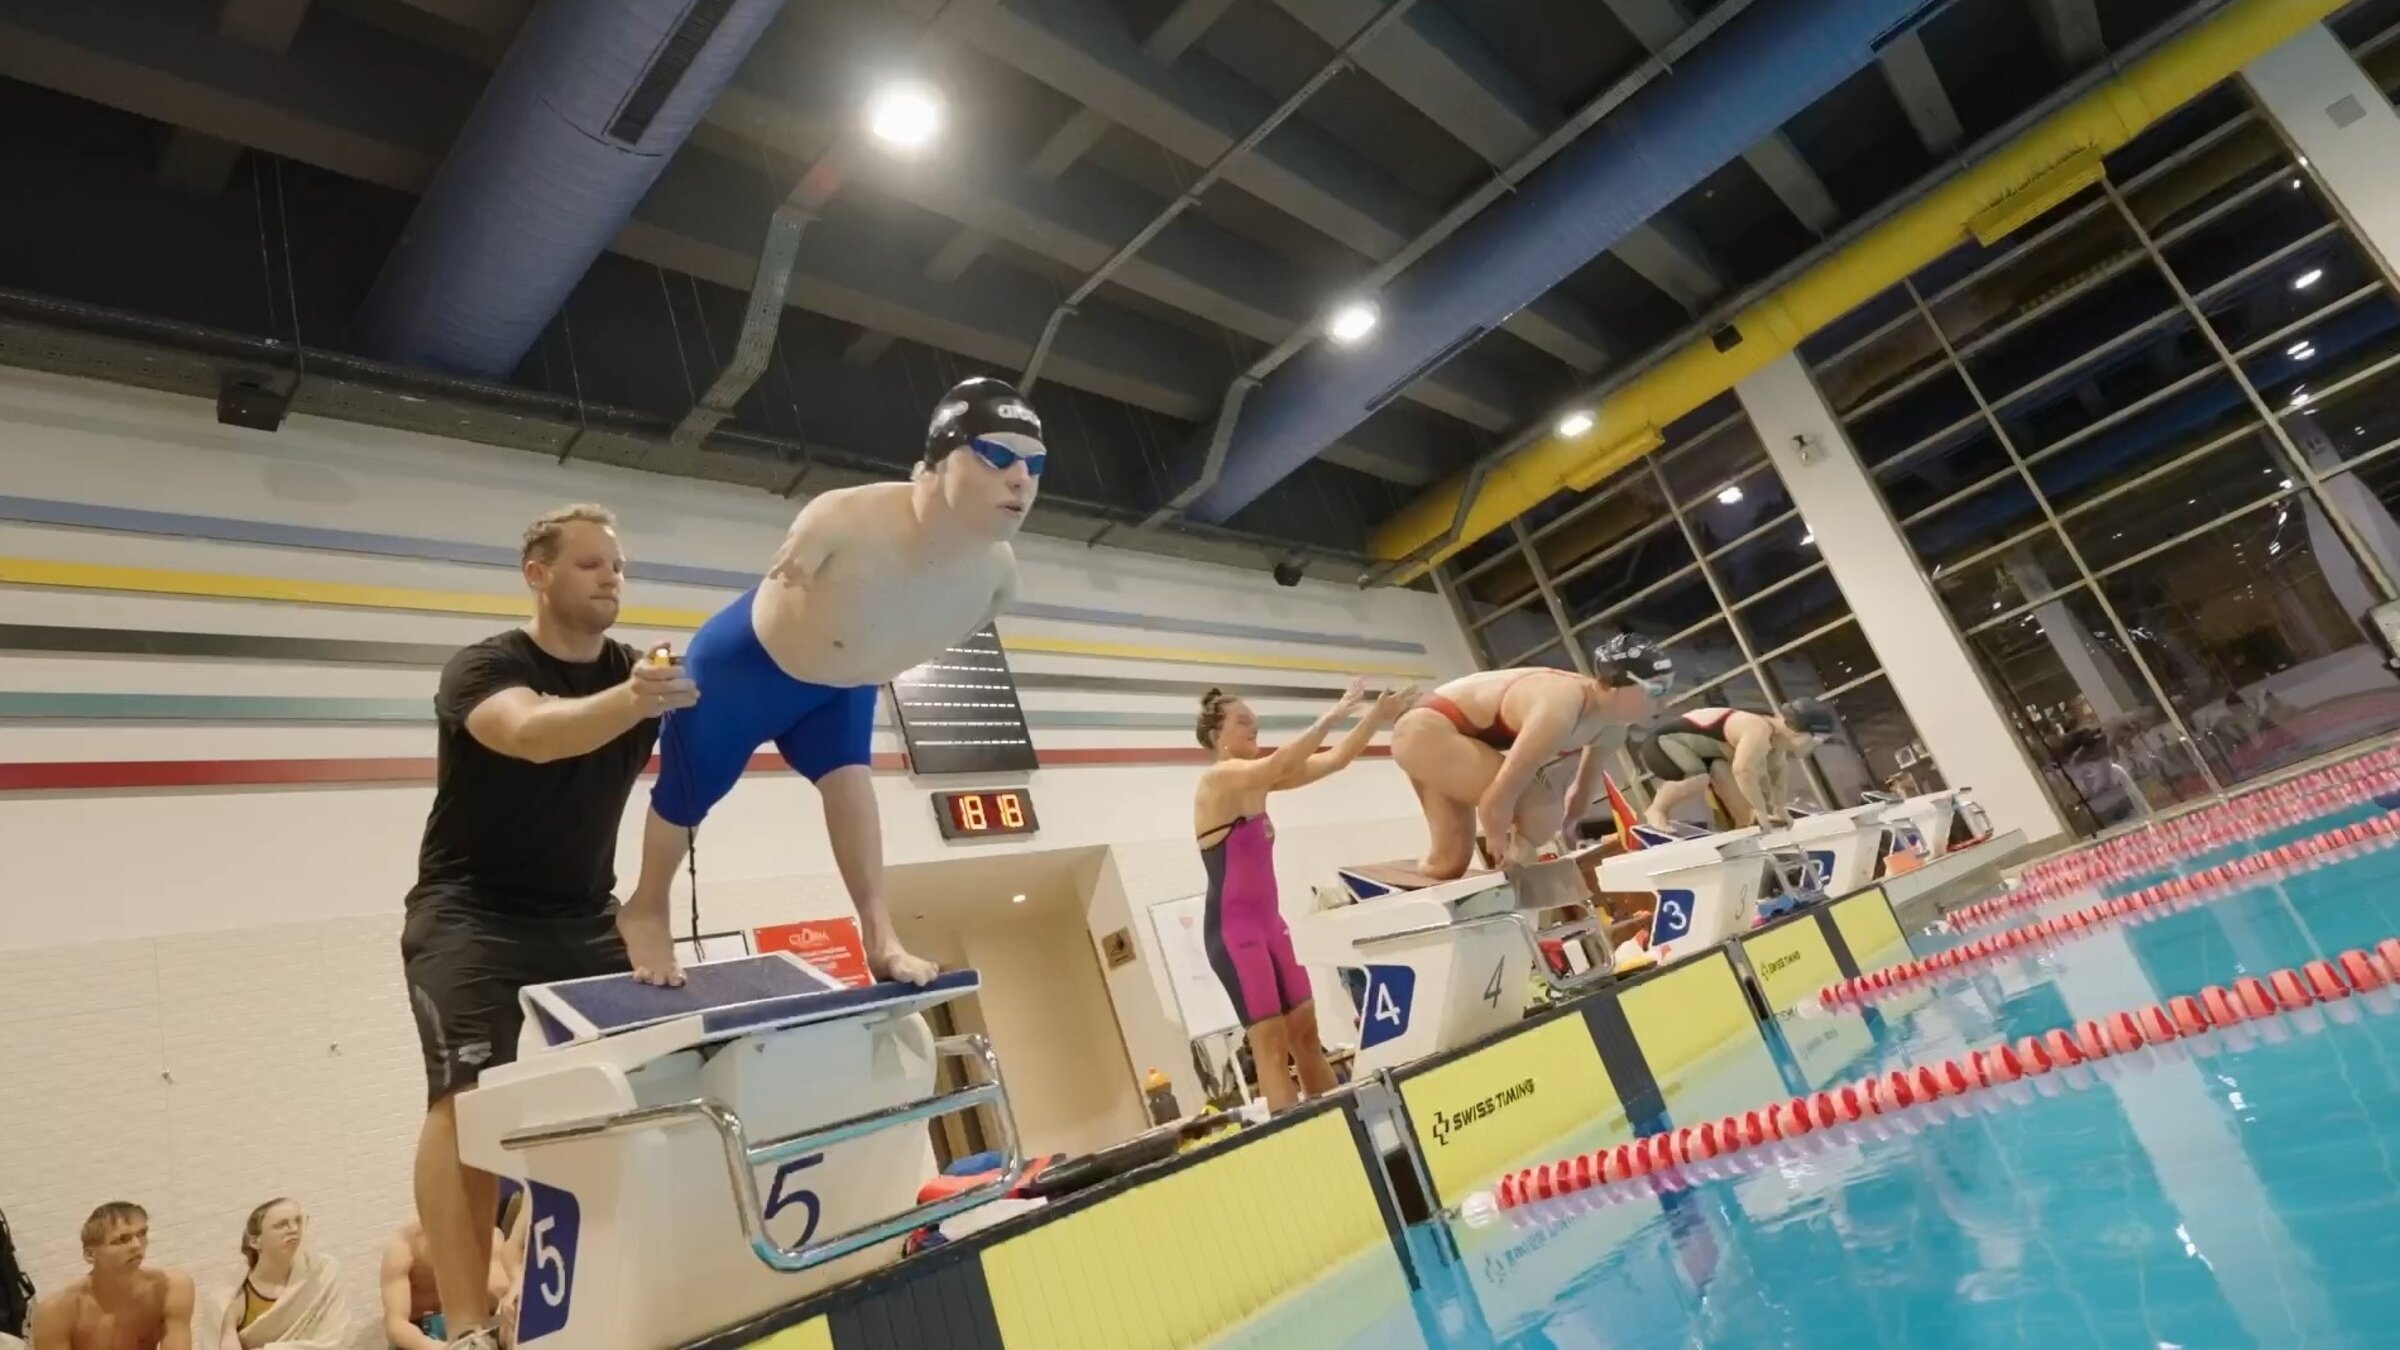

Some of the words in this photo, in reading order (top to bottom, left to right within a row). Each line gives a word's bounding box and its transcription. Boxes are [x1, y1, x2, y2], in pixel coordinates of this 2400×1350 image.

[959, 795, 987, 830] 18
[996, 794, 1025, 829] 18
[1661, 901, 1687, 930] 3
[1374, 982, 1401, 1026] 4
[1483, 955, 1506, 1009] 4
[1452, 1097, 1496, 1132] SWISS
[1495, 1078, 1536, 1110] TIMING
[764, 1152, 824, 1248] 5
[532, 1214, 566, 1308] 5
